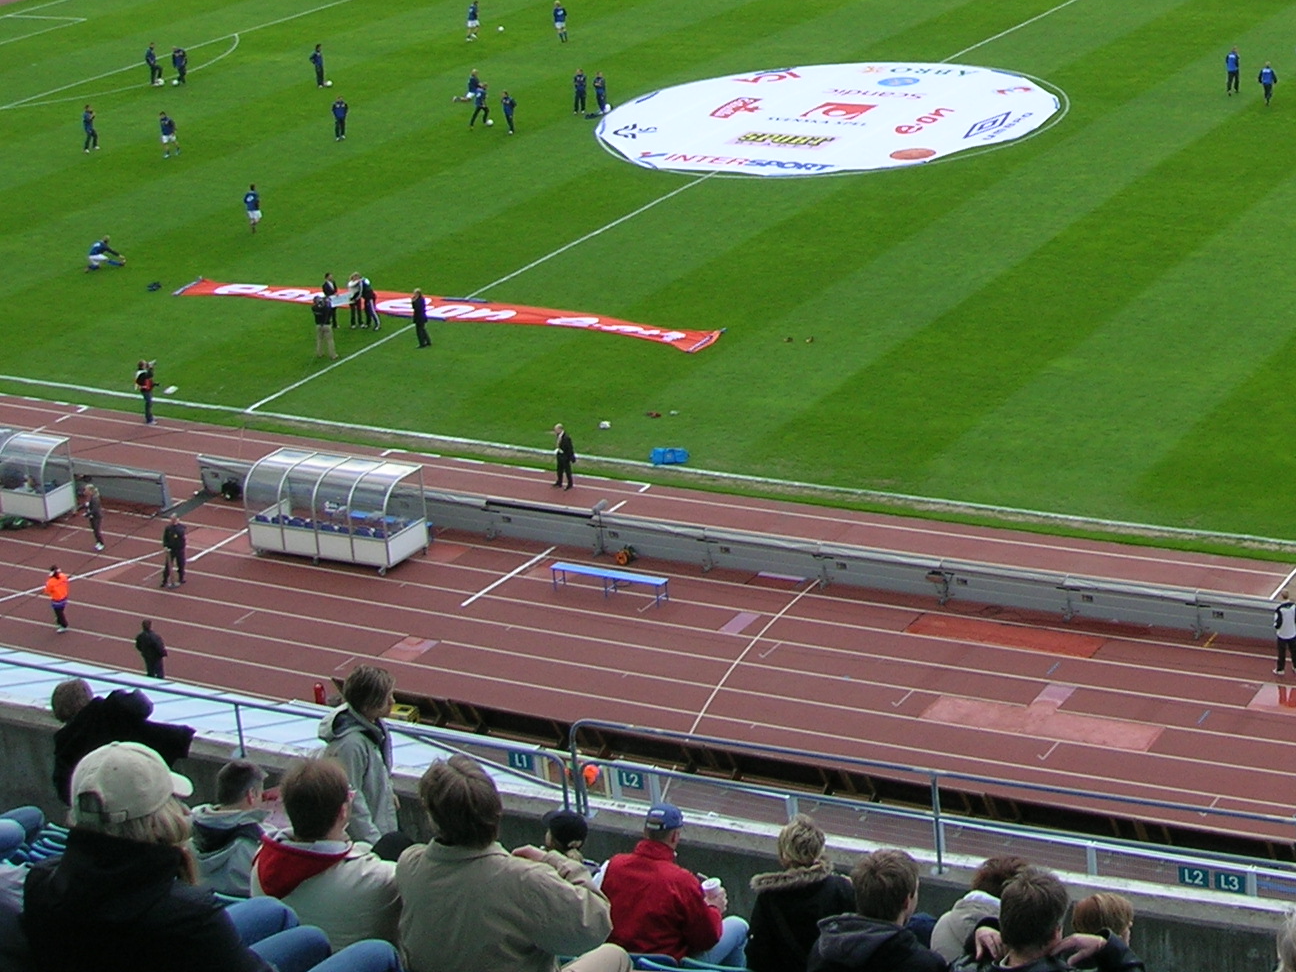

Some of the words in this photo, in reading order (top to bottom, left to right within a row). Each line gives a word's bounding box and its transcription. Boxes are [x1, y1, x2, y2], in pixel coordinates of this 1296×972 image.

[664, 153, 835, 171] INTERSPORT
[514, 755, 529, 769] L1
[621, 771, 641, 788] L2
[1184, 867, 1205, 886] L2
[1220, 875, 1240, 892] L3
